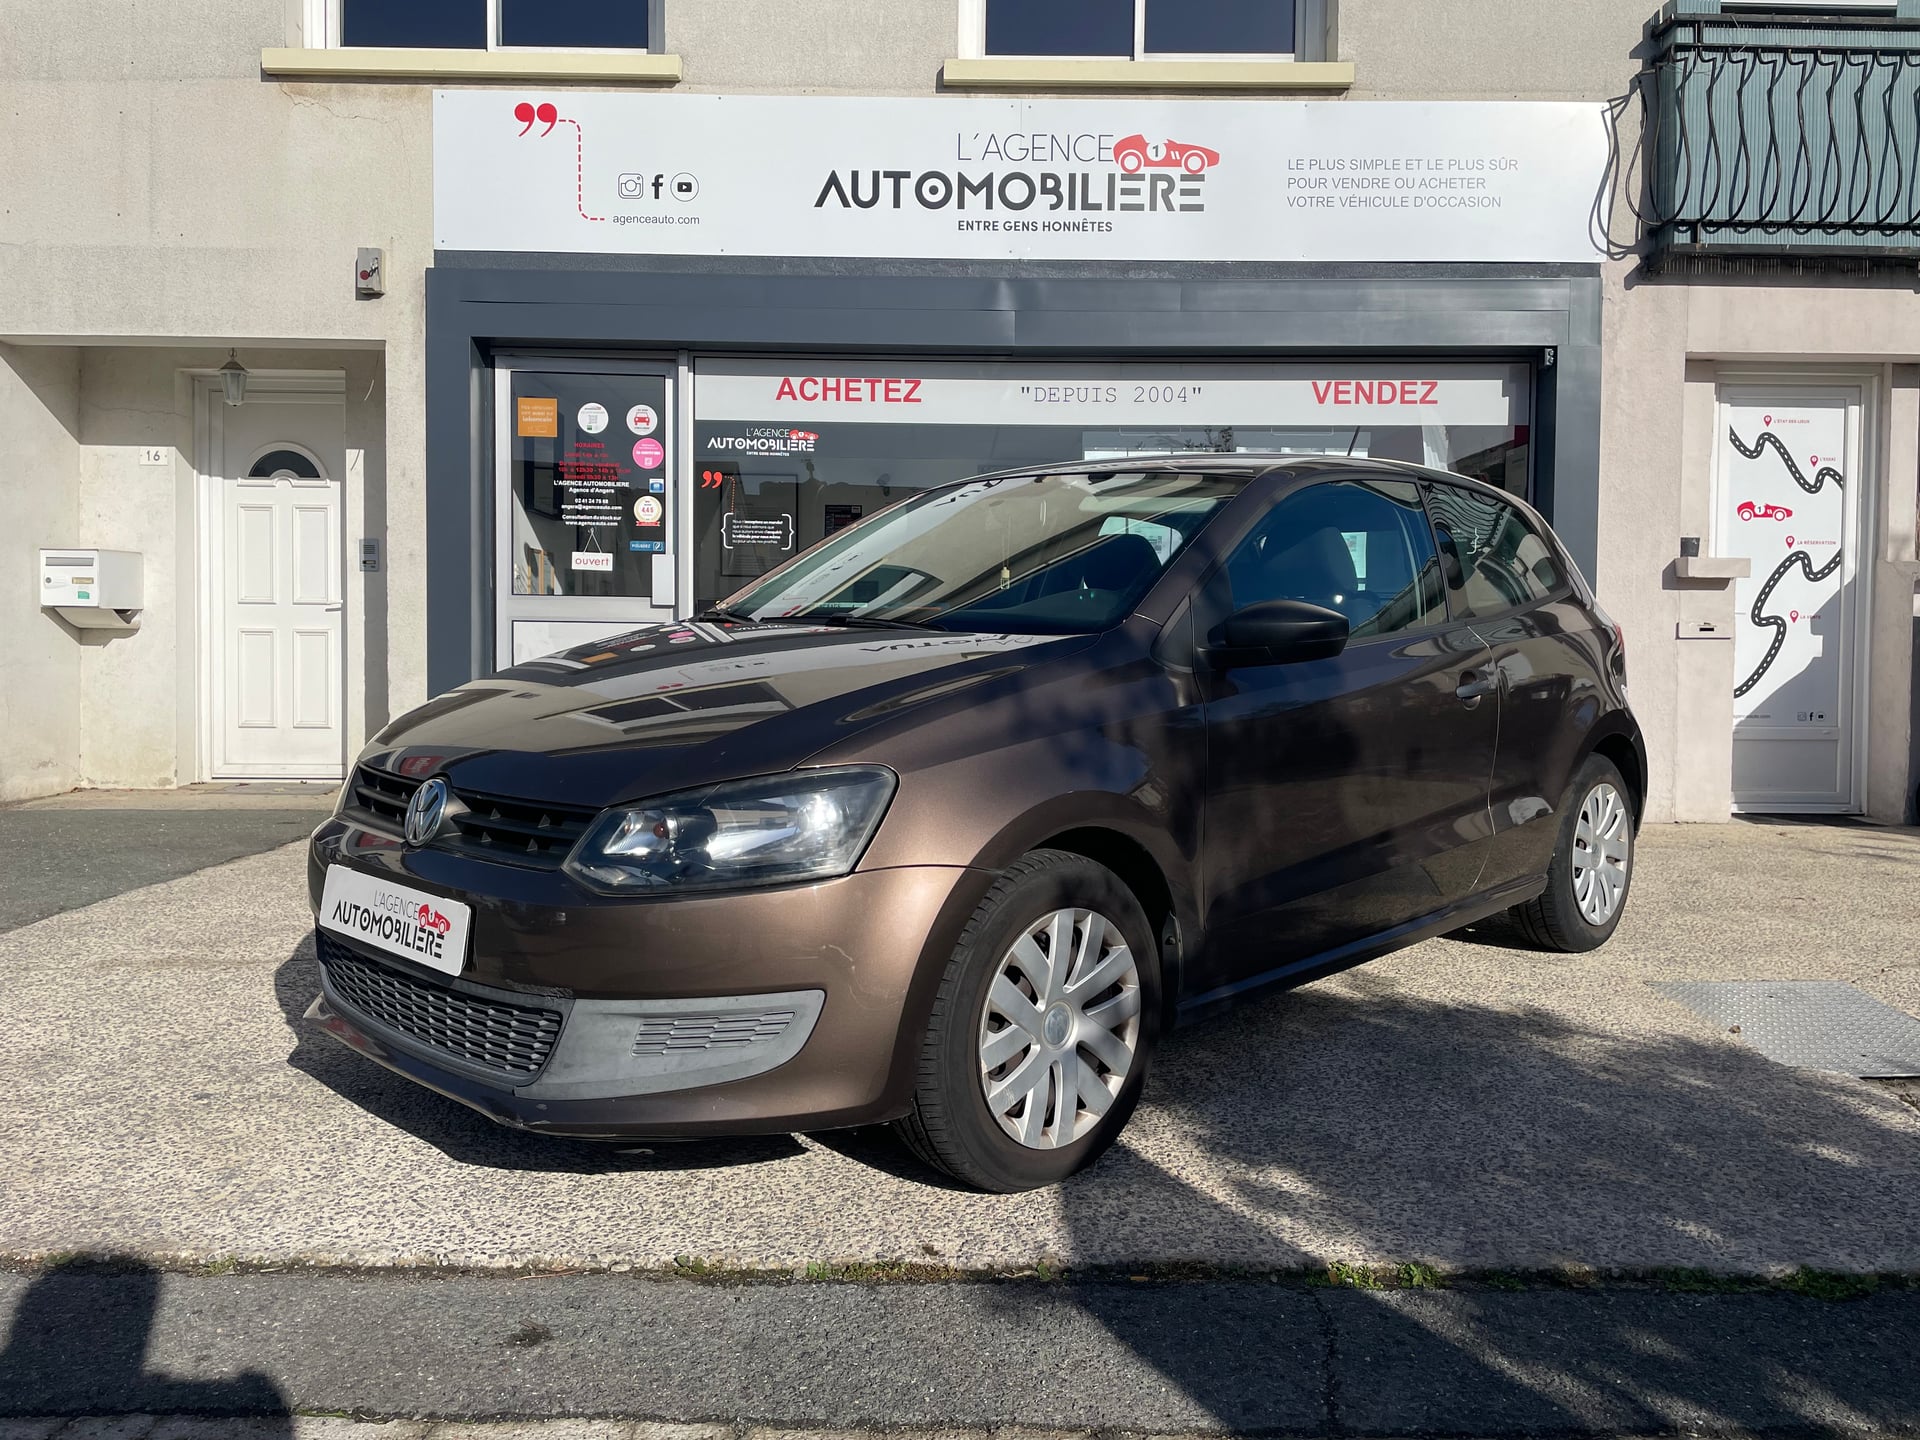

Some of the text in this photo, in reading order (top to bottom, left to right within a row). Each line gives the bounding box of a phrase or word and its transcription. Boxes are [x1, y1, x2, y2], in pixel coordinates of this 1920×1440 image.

[957, 132, 1114, 163] L'AGENCE
[1288, 156, 1518, 171] LE PLUS SIMPLE ET LE PLUS SÛR
[1287, 177, 1486, 189] POUR VENDRE OU ACHETER
[1287, 194, 1502, 208] VOTRE VÉHICULE D'OCCASION
[612, 214, 700, 226] agenceauto.com
[957, 218, 1113, 232] ENTRE GENS HONNÊTES
[775, 377, 922, 403] ACHETEZ
[1020, 386, 1202, 403] "DEPUIS 2004"
[1311, 381, 1439, 405] VENDEZ
[746, 428, 790, 438] L'AGENCE
[146, 450, 160, 462] 16
[575, 557, 609, 566] ouvert
[374, 889, 420, 920] L'AGENCE
